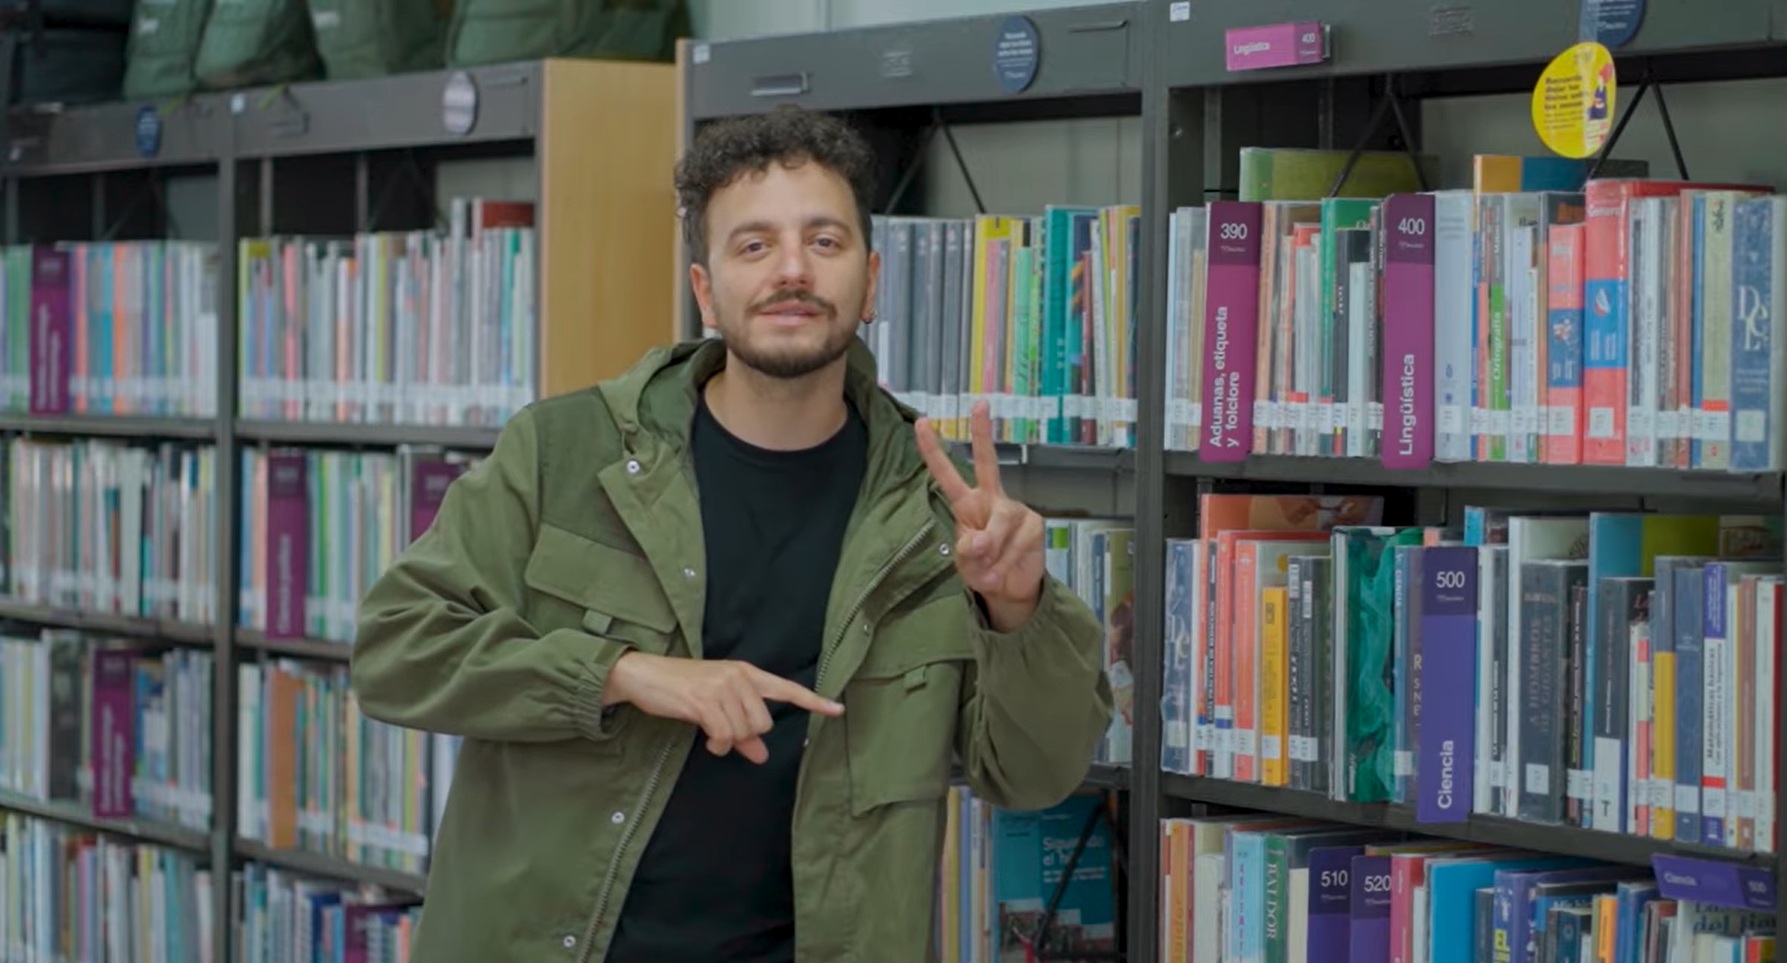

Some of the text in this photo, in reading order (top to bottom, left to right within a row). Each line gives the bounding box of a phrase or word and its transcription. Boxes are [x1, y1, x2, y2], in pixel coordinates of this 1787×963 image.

[1220, 222, 1248, 240] 390
[1398, 218, 1425, 236] 400
[1209, 306, 1229, 448] Aduanas, etiqueta
[1227, 371, 1240, 448] y folclore
[1399, 354, 1416, 456] Lingüística
[1435, 570, 1466, 589] 500
[1438, 740, 1454, 810] Ciencia
[1266, 862, 1278, 939] BALDOR
[1320, 869, 1349, 888] 510
[1363, 874, 1392, 893] 520
